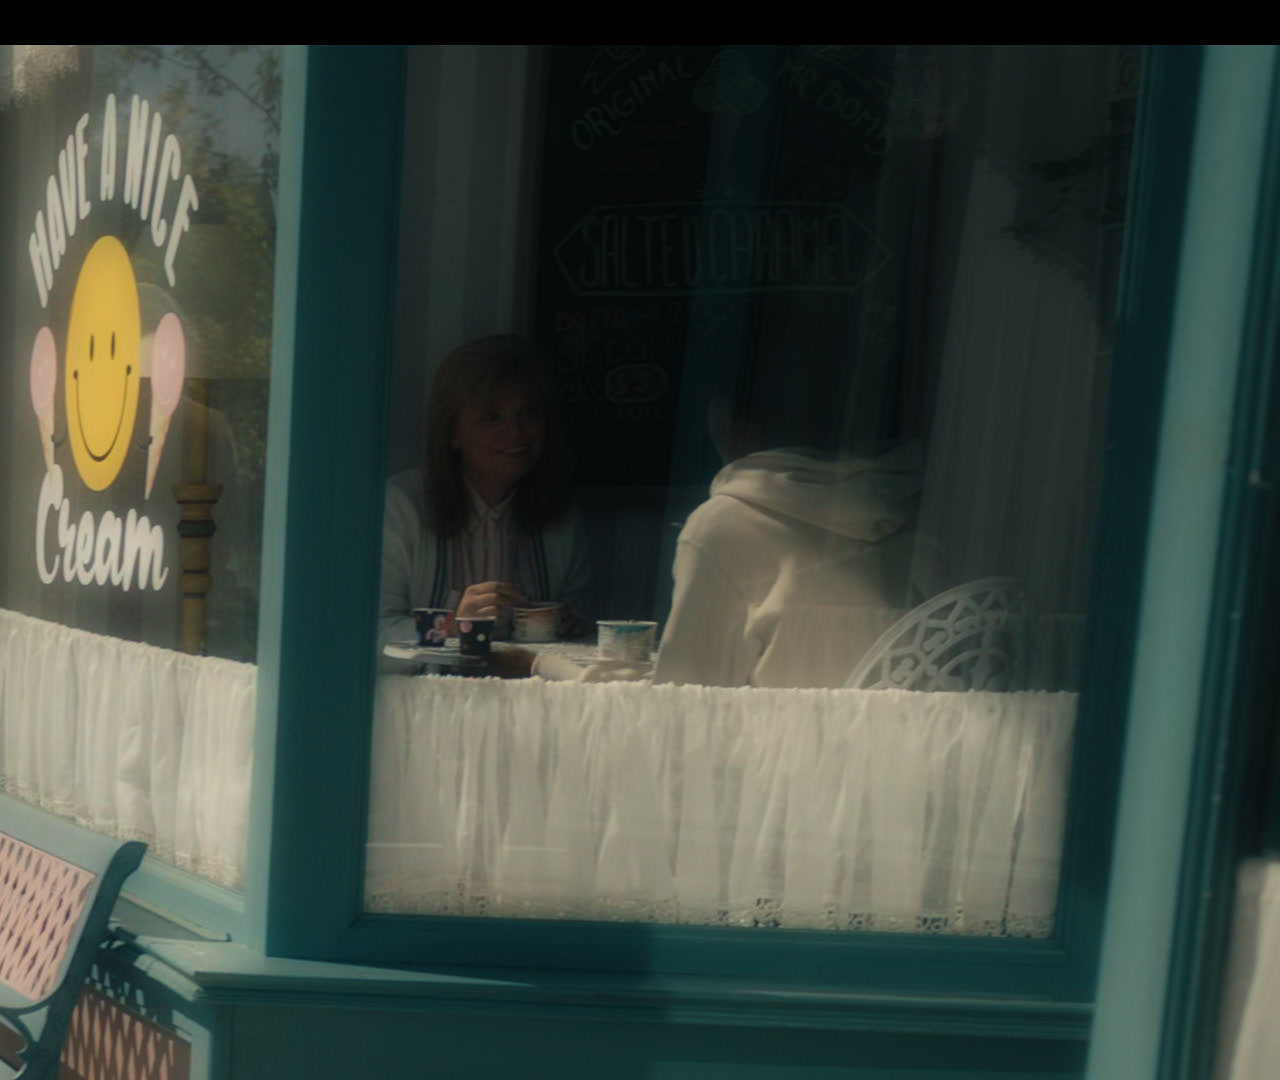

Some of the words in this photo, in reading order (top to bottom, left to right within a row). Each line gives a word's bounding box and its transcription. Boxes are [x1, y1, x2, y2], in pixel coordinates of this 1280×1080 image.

[571, 56, 693, 151] ORIGINAL
[28, 112, 90, 308] HAVE
[100, 93, 117, 202] A
[124, 93, 199, 287] NICE
[36, 464, 168, 591] Cream
